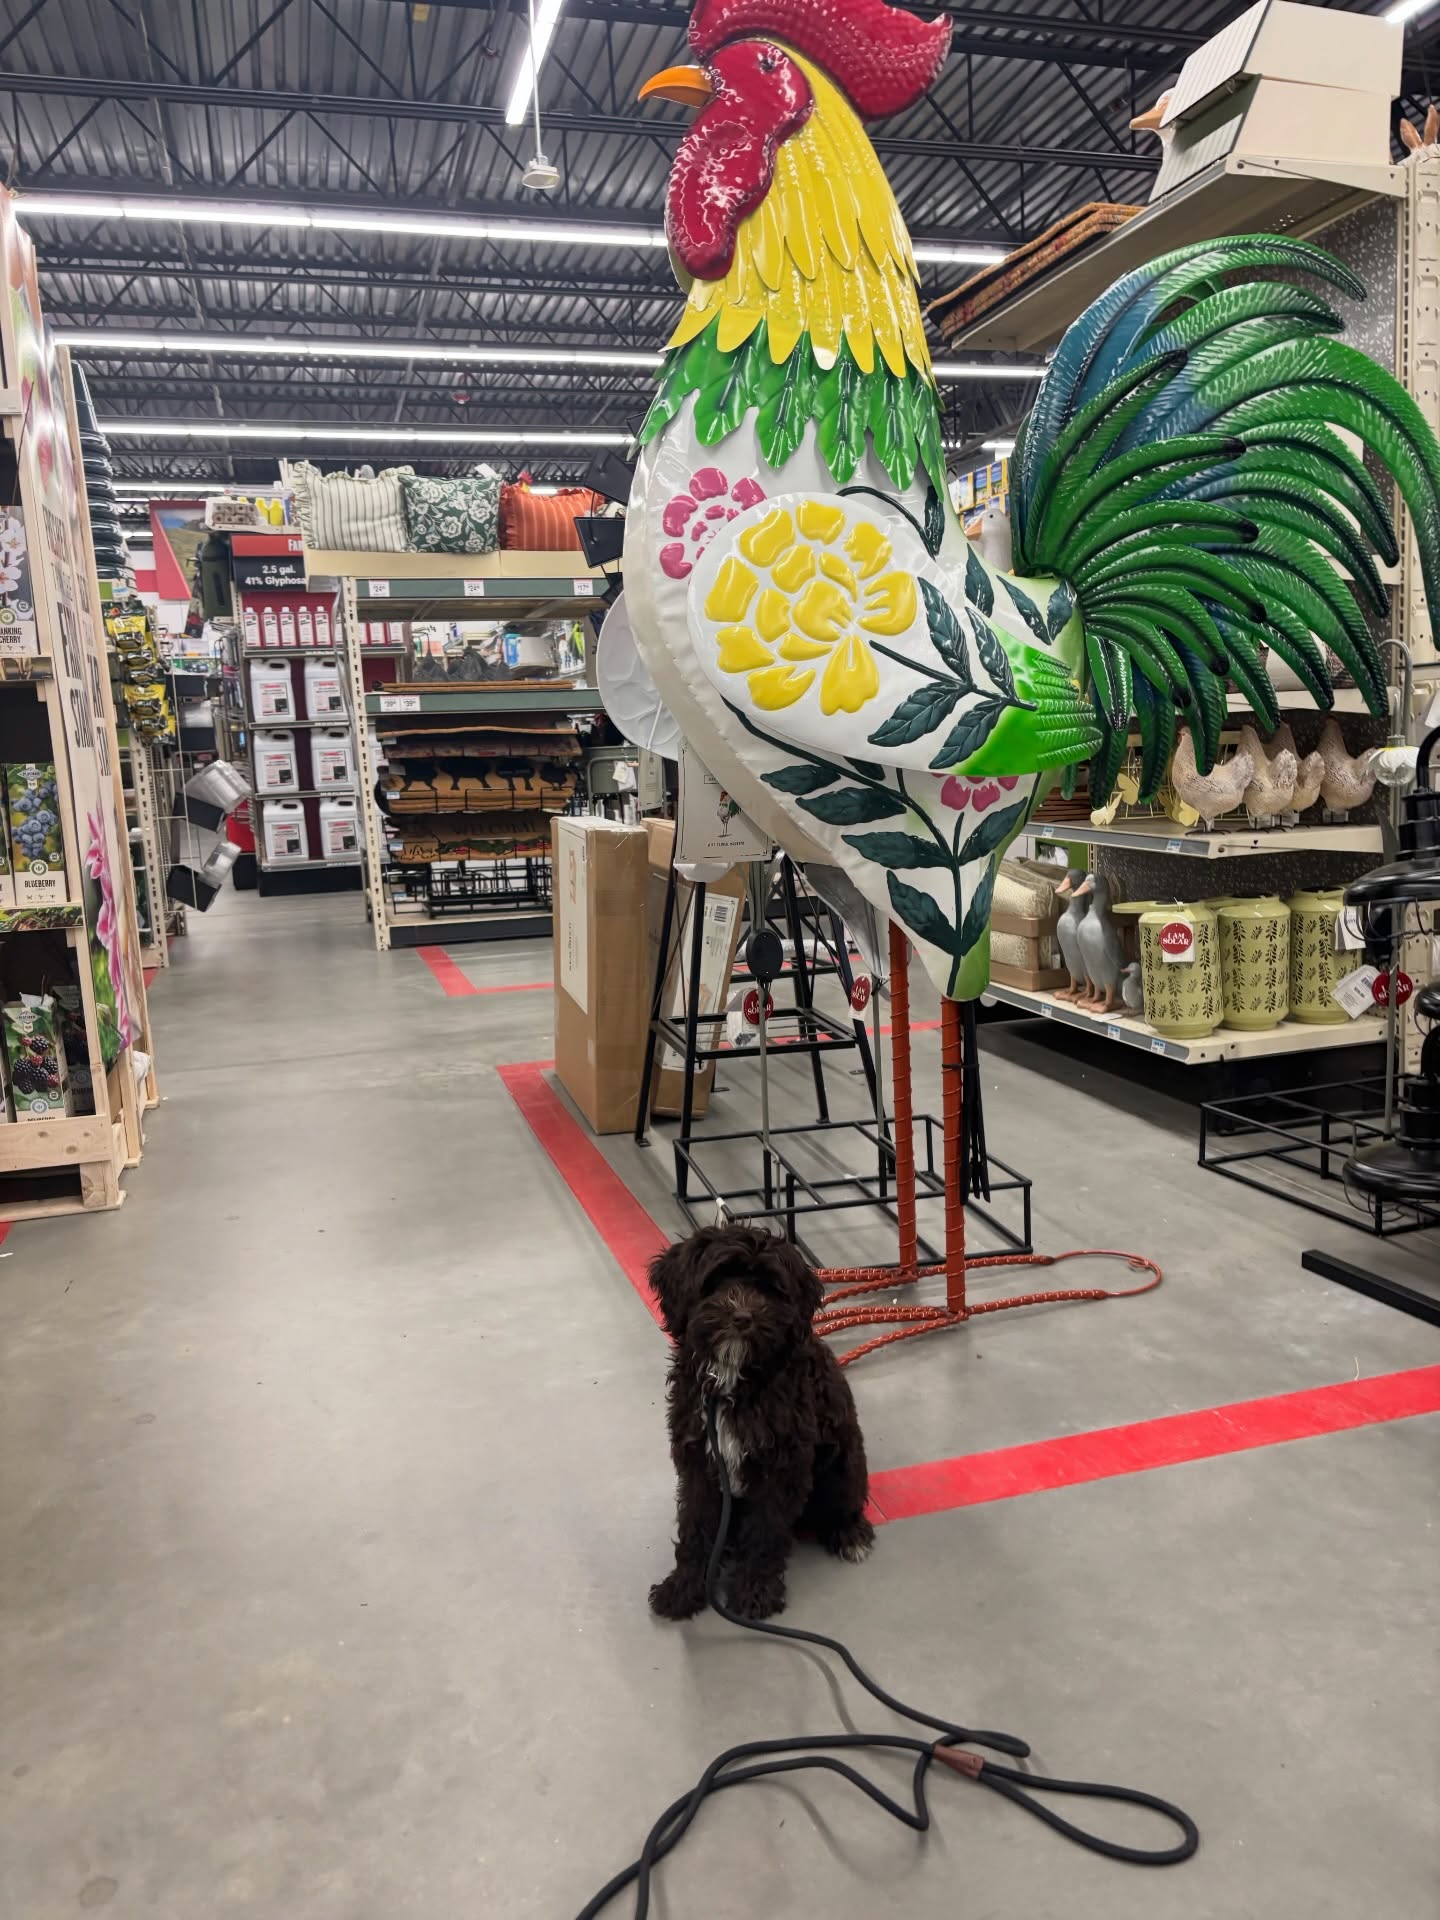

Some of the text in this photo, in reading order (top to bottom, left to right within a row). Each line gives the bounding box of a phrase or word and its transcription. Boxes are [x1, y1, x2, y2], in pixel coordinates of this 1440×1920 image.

[262, 565, 296, 575] 2.5 gal.
[245, 576, 306, 587] 41% Glyphosa
[24, 880, 56, 888] BLUEBERRY
[1162, 938, 1189, 946] SOLAR
